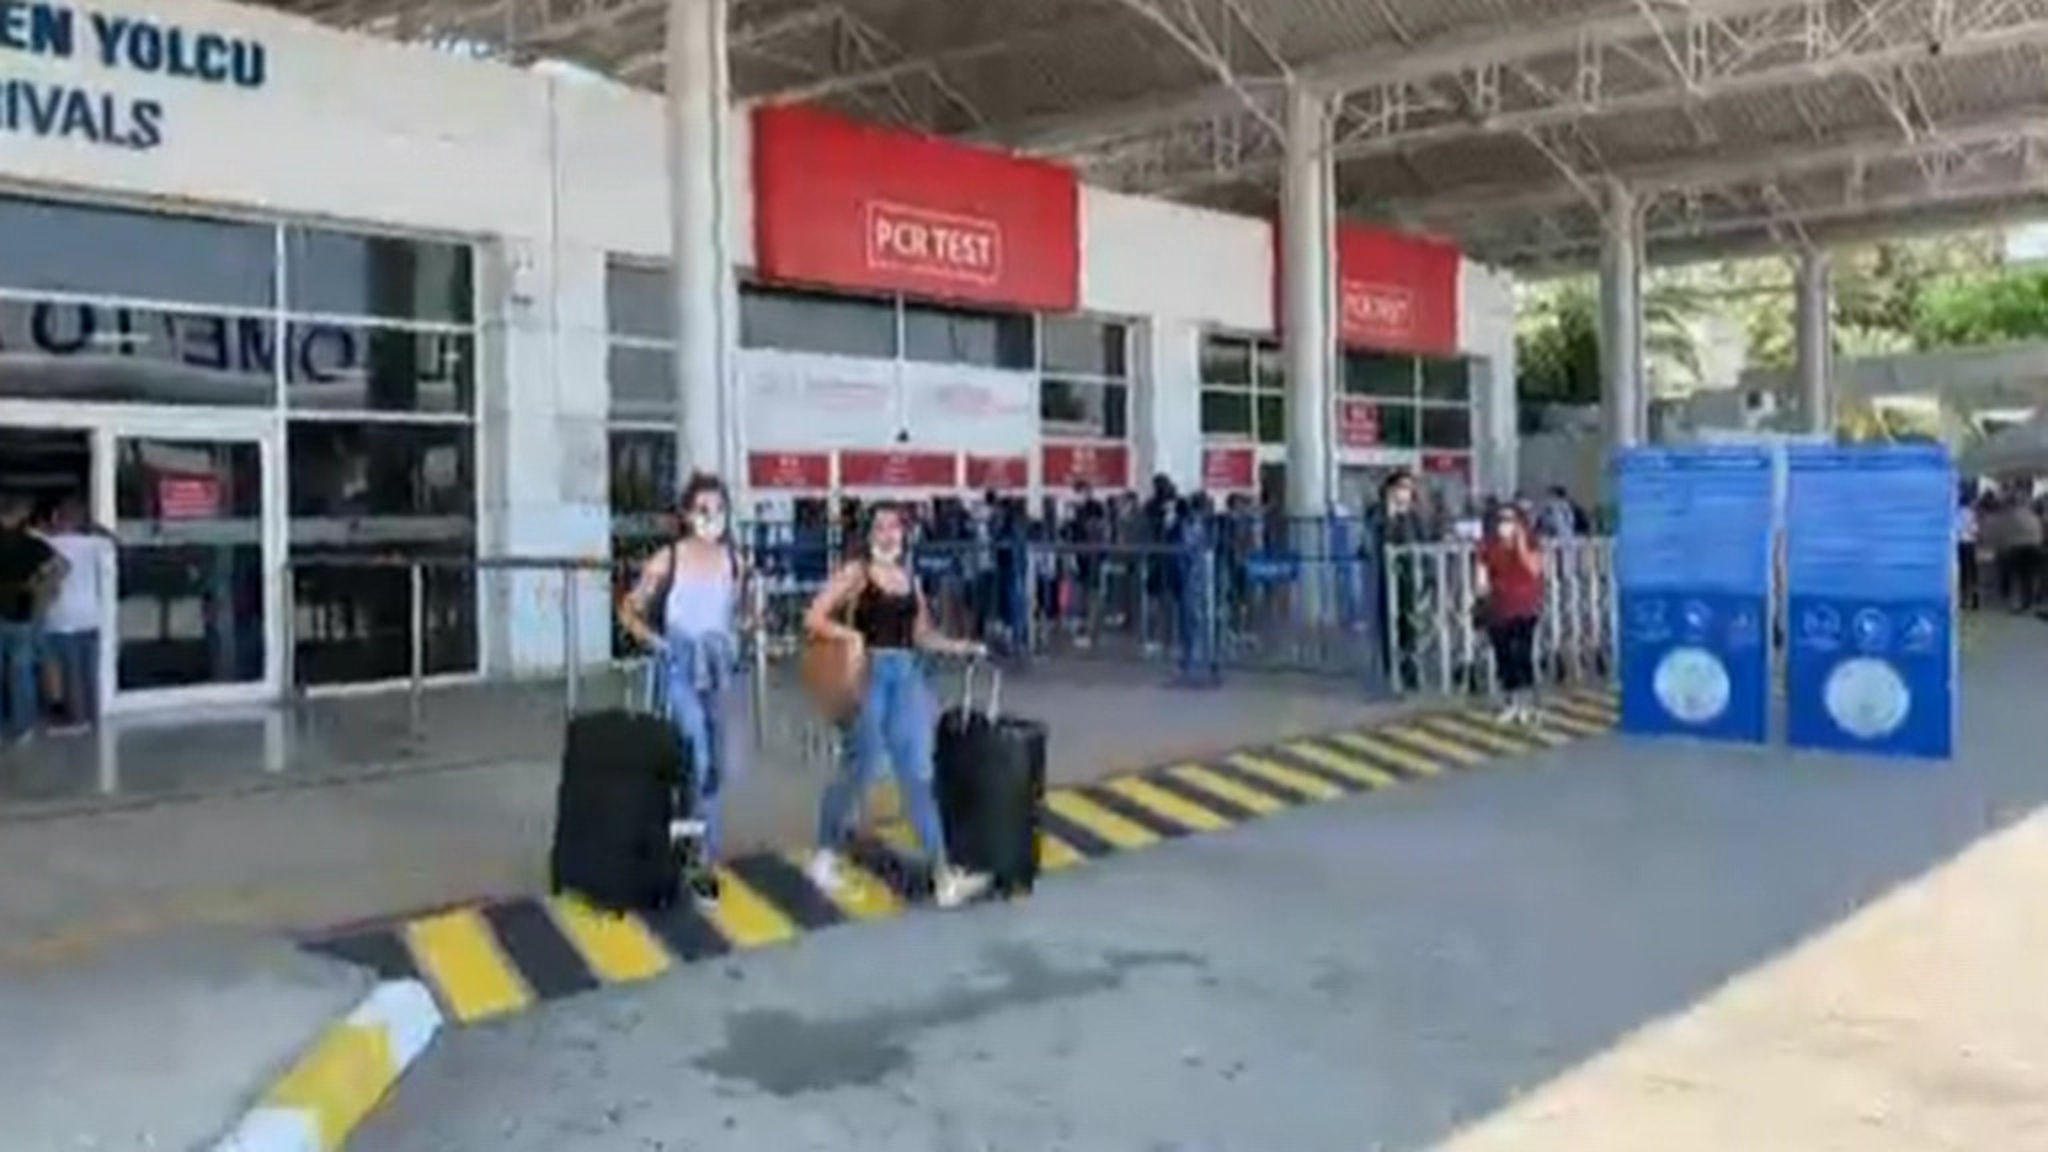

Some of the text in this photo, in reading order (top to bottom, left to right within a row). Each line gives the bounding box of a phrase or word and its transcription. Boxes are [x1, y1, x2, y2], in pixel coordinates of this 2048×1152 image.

[92, 12, 267, 87] YOLCU
[0, 79, 163, 150] IVALS
[875, 215, 992, 266] PCR TEST
